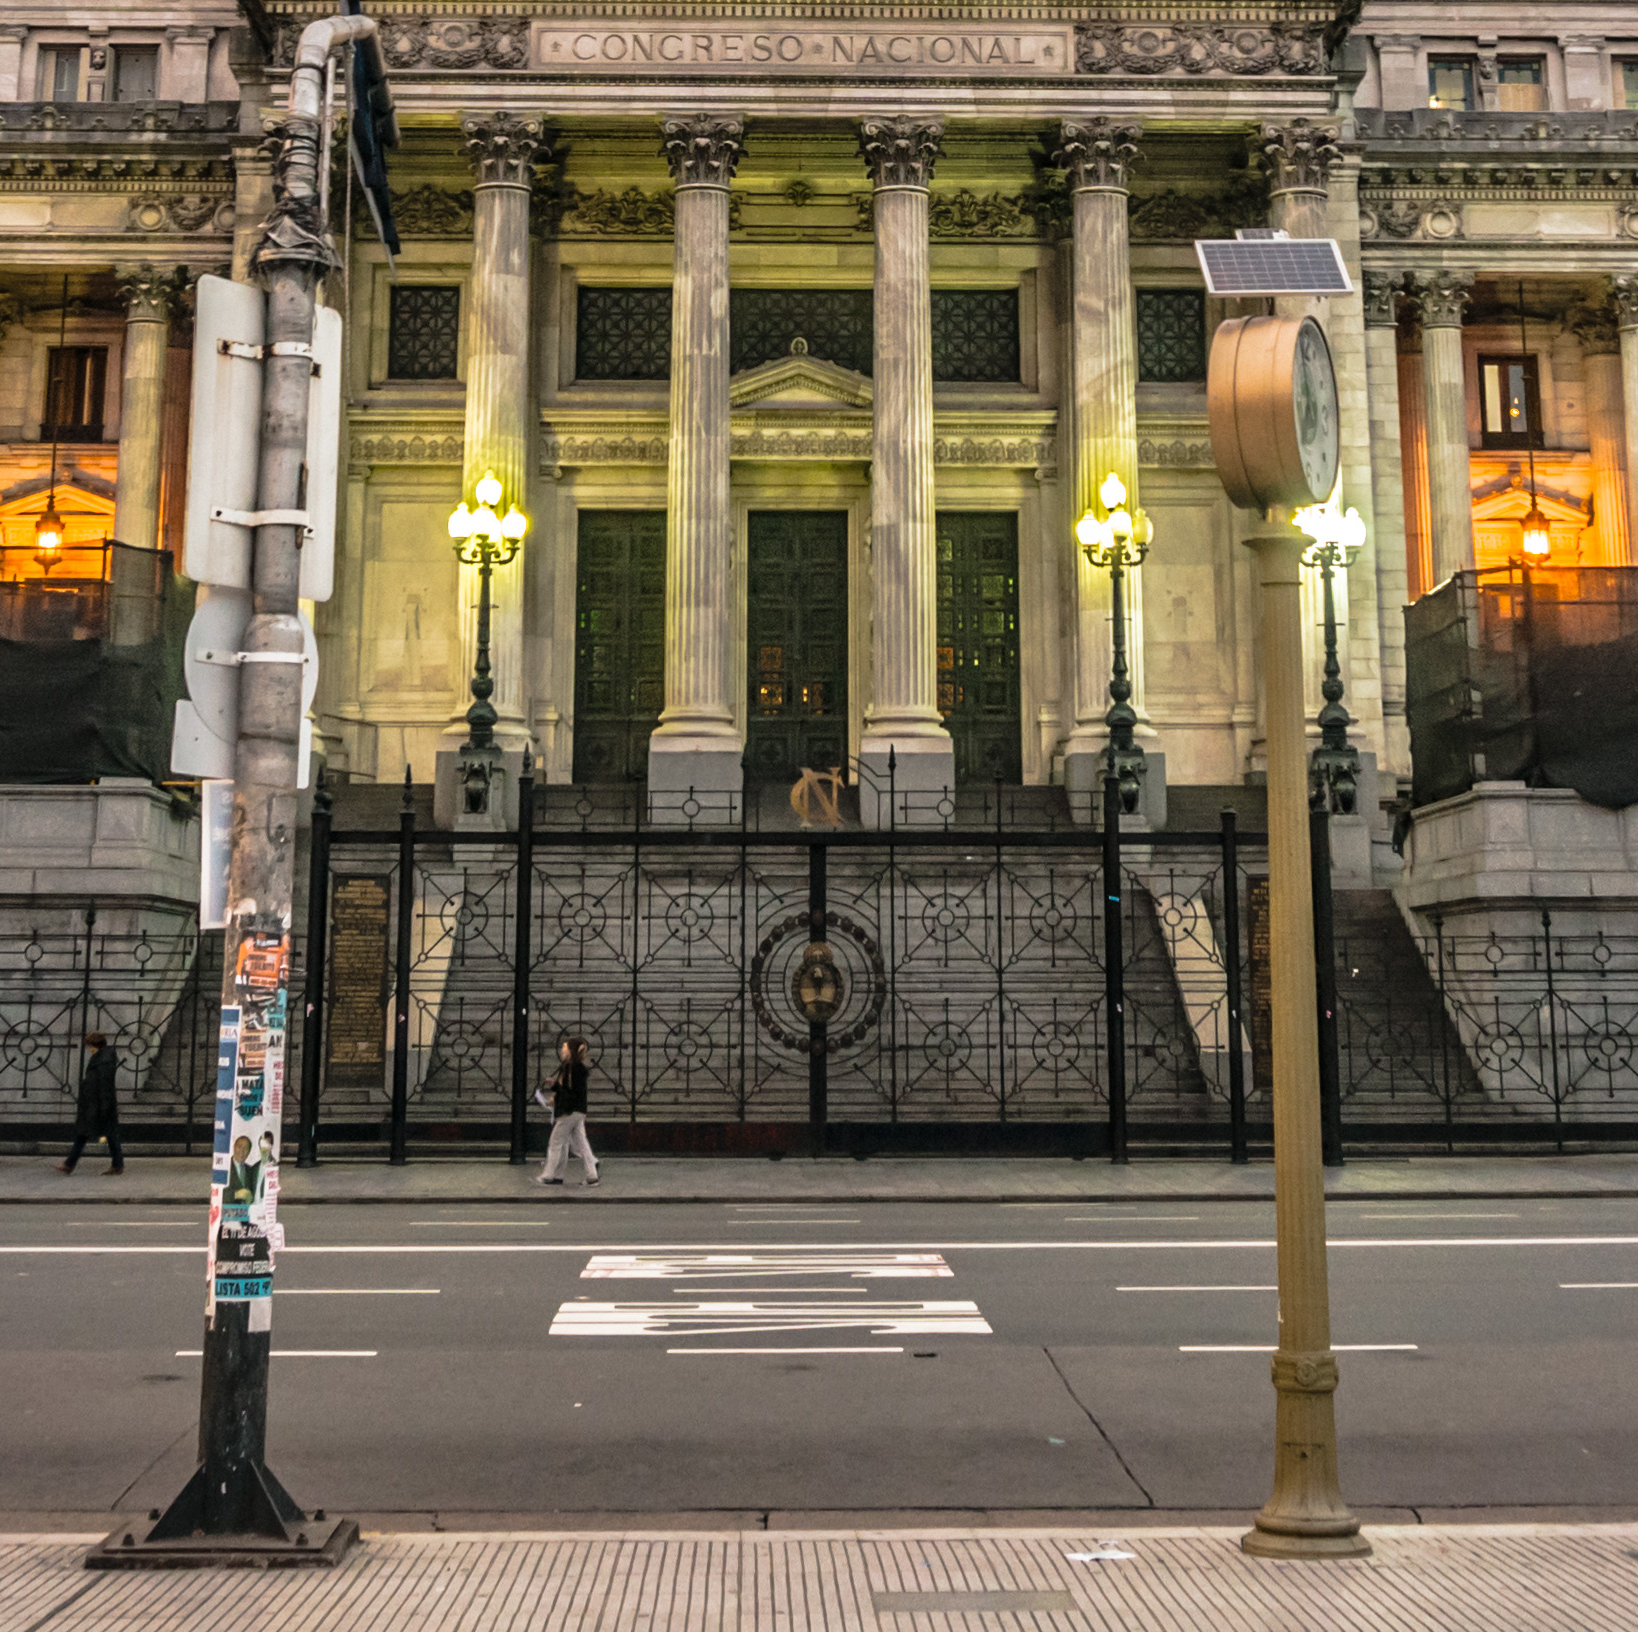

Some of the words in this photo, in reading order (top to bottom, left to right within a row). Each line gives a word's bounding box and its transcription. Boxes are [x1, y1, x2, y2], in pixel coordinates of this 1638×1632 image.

[572, 32, 804, 65] CONGRESO
[831, 33, 1036, 67] NACIONAL
[239, 1243, 256, 1257] VOTE
[216, 1261, 252, 1274] COMPROMISO
[216, 1281, 241, 1296] LISTA
[244, 1281, 260, 1296] 502
